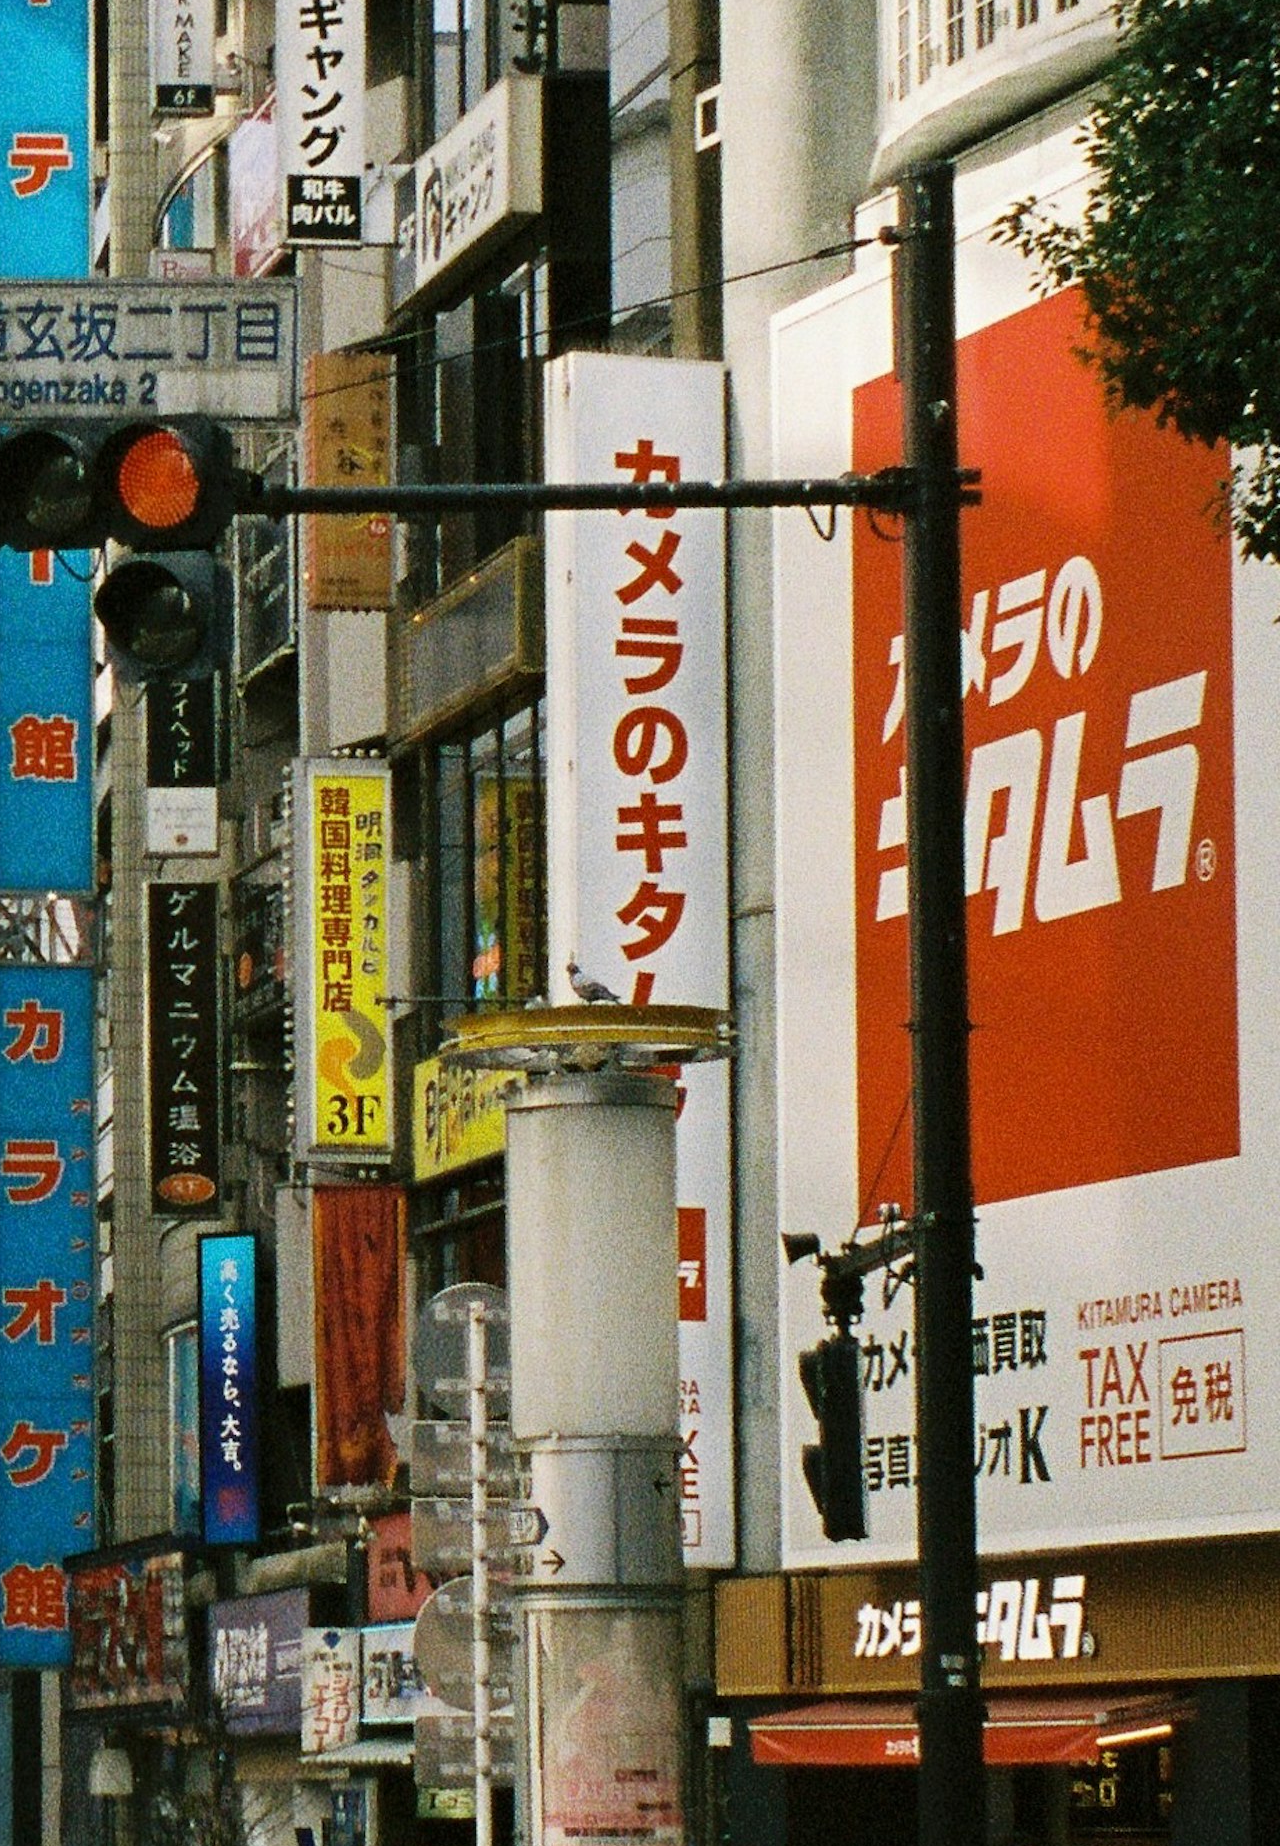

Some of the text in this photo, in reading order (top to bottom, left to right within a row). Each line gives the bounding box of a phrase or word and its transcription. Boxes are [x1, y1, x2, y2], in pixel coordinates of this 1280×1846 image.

[173, 89, 196, 105] 6F
[291, 200, 357, 227] 肉バル
[300, 178, 346, 201] 和牛
[137, 372, 160, 405] 2
[612, 439, 689, 1007] カメラのキタ
[319, 786, 354, 1013] 韓国料理専門店
[167, 889, 202, 1166] ゲルマニウム温浴
[327, 1095, 382, 1137] 3F
[0, 1001, 69, 1633] カラオケ館
[1078, 1277, 1243, 1331] KITAMURA CAMERA
[1079, 1340, 1152, 1409] TAX
[1170, 1359, 1235, 1427] 免税
[1080, 1409, 1153, 1470] FREE
[855, 1574, 1088, 1661] カメラタムラ
